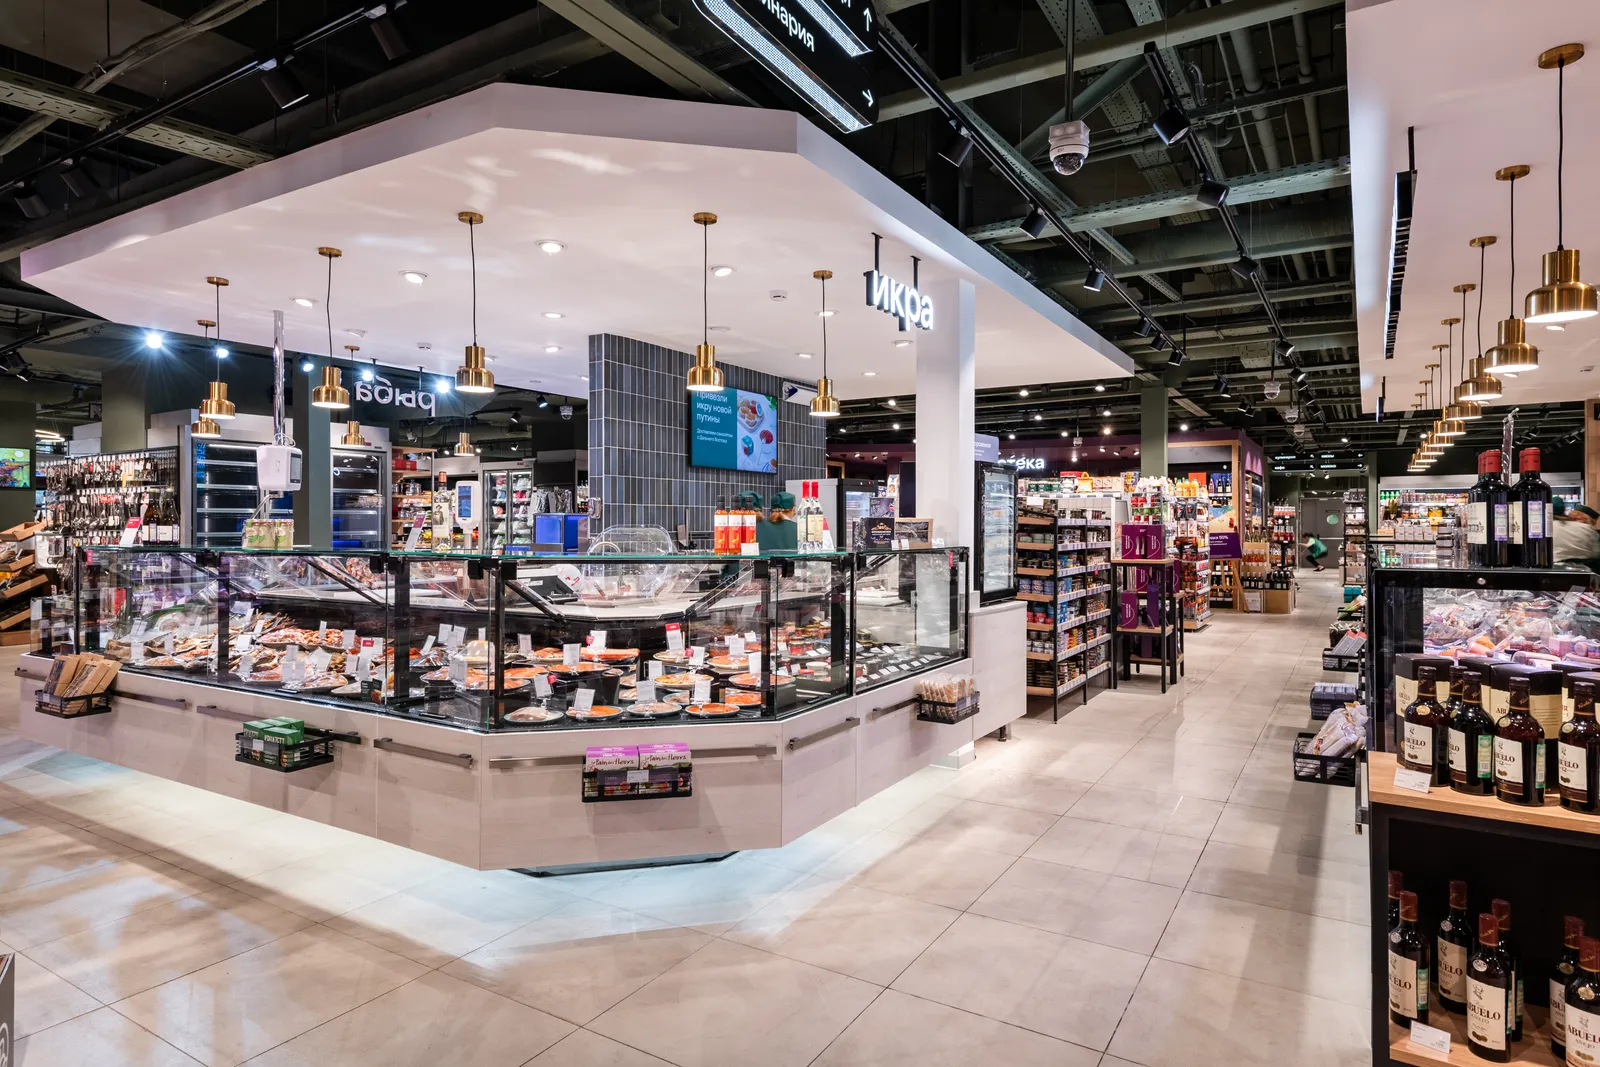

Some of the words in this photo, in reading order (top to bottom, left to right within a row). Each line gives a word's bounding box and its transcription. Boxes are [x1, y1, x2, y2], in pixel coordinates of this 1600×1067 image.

[873, 270, 934, 330] икра
[697, 392, 727, 402] Привезли
[697, 402, 712, 412] икру
[713, 405, 731, 414] новой
[697, 414, 720, 423] путины
